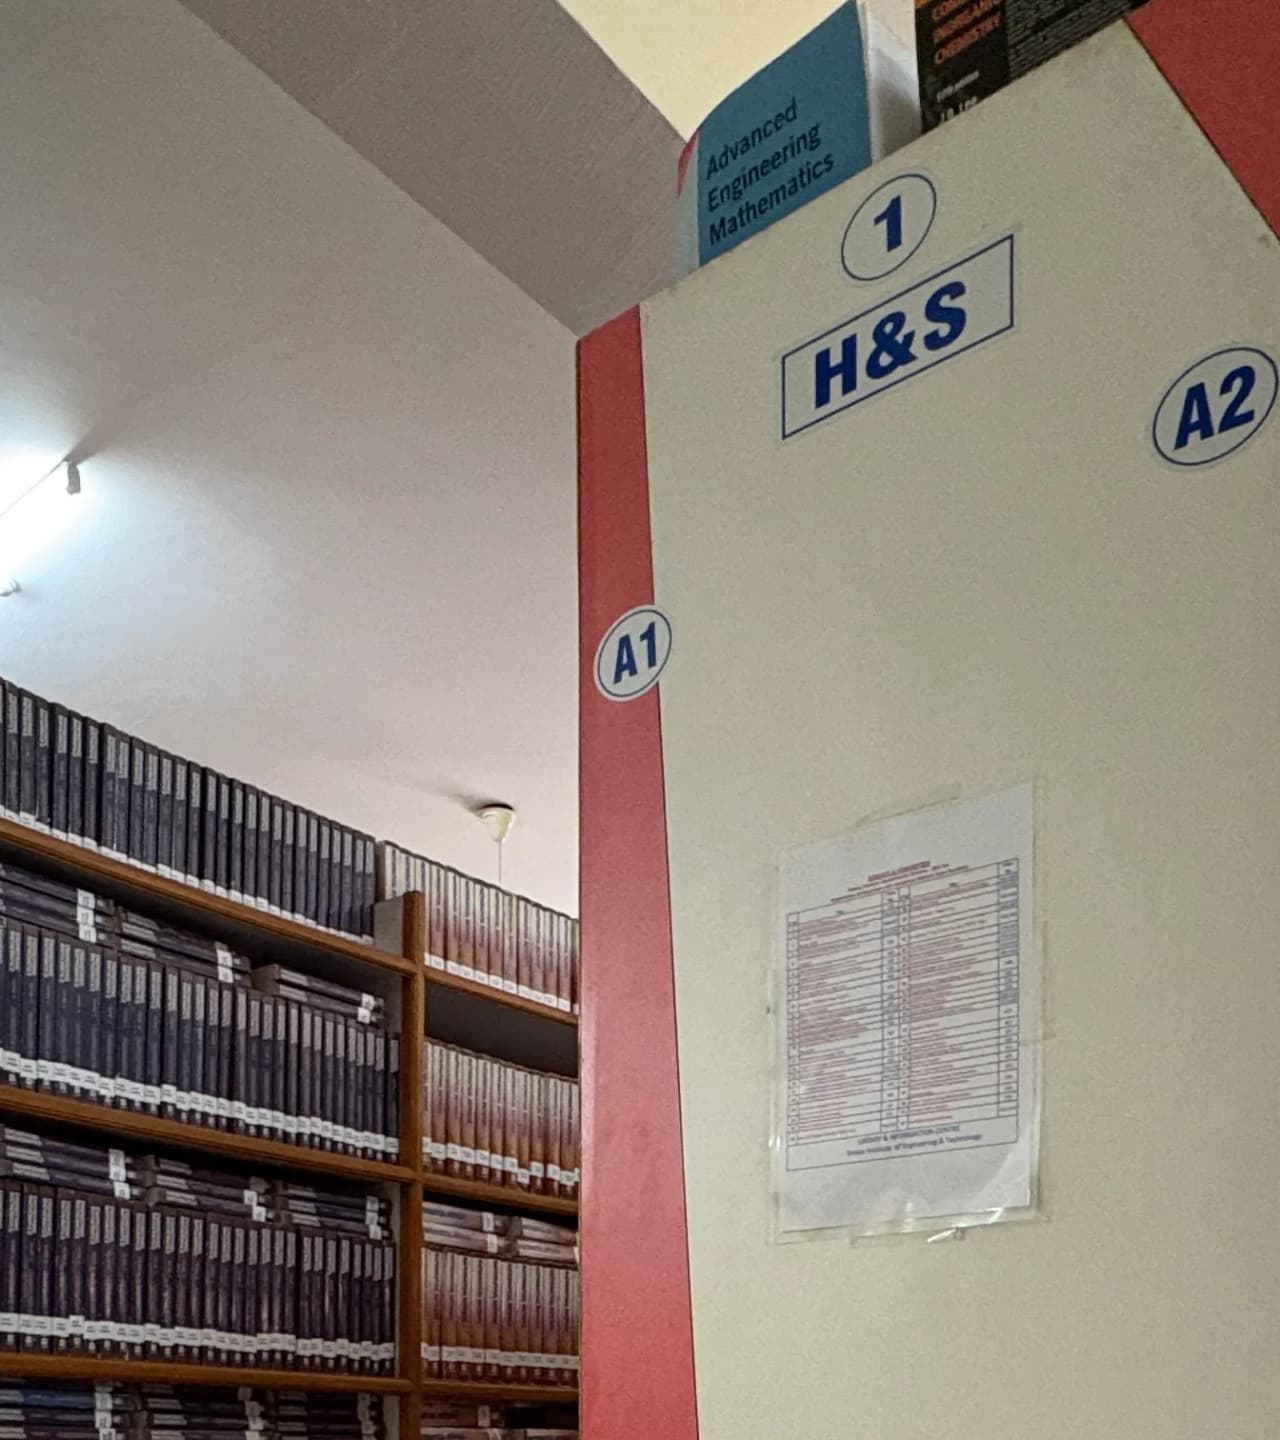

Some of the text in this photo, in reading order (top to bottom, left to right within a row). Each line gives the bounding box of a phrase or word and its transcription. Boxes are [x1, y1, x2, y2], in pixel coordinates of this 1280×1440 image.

[706, 97, 797, 180] Advanced
[708, 124, 821, 212] Engineering
[710, 153, 834, 246] Mathematics
[873, 197, 906, 251] 1
[813, 280, 967, 410] H&S
[1173, 366, 1256, 450] A2
[612, 622, 657, 685] A1
